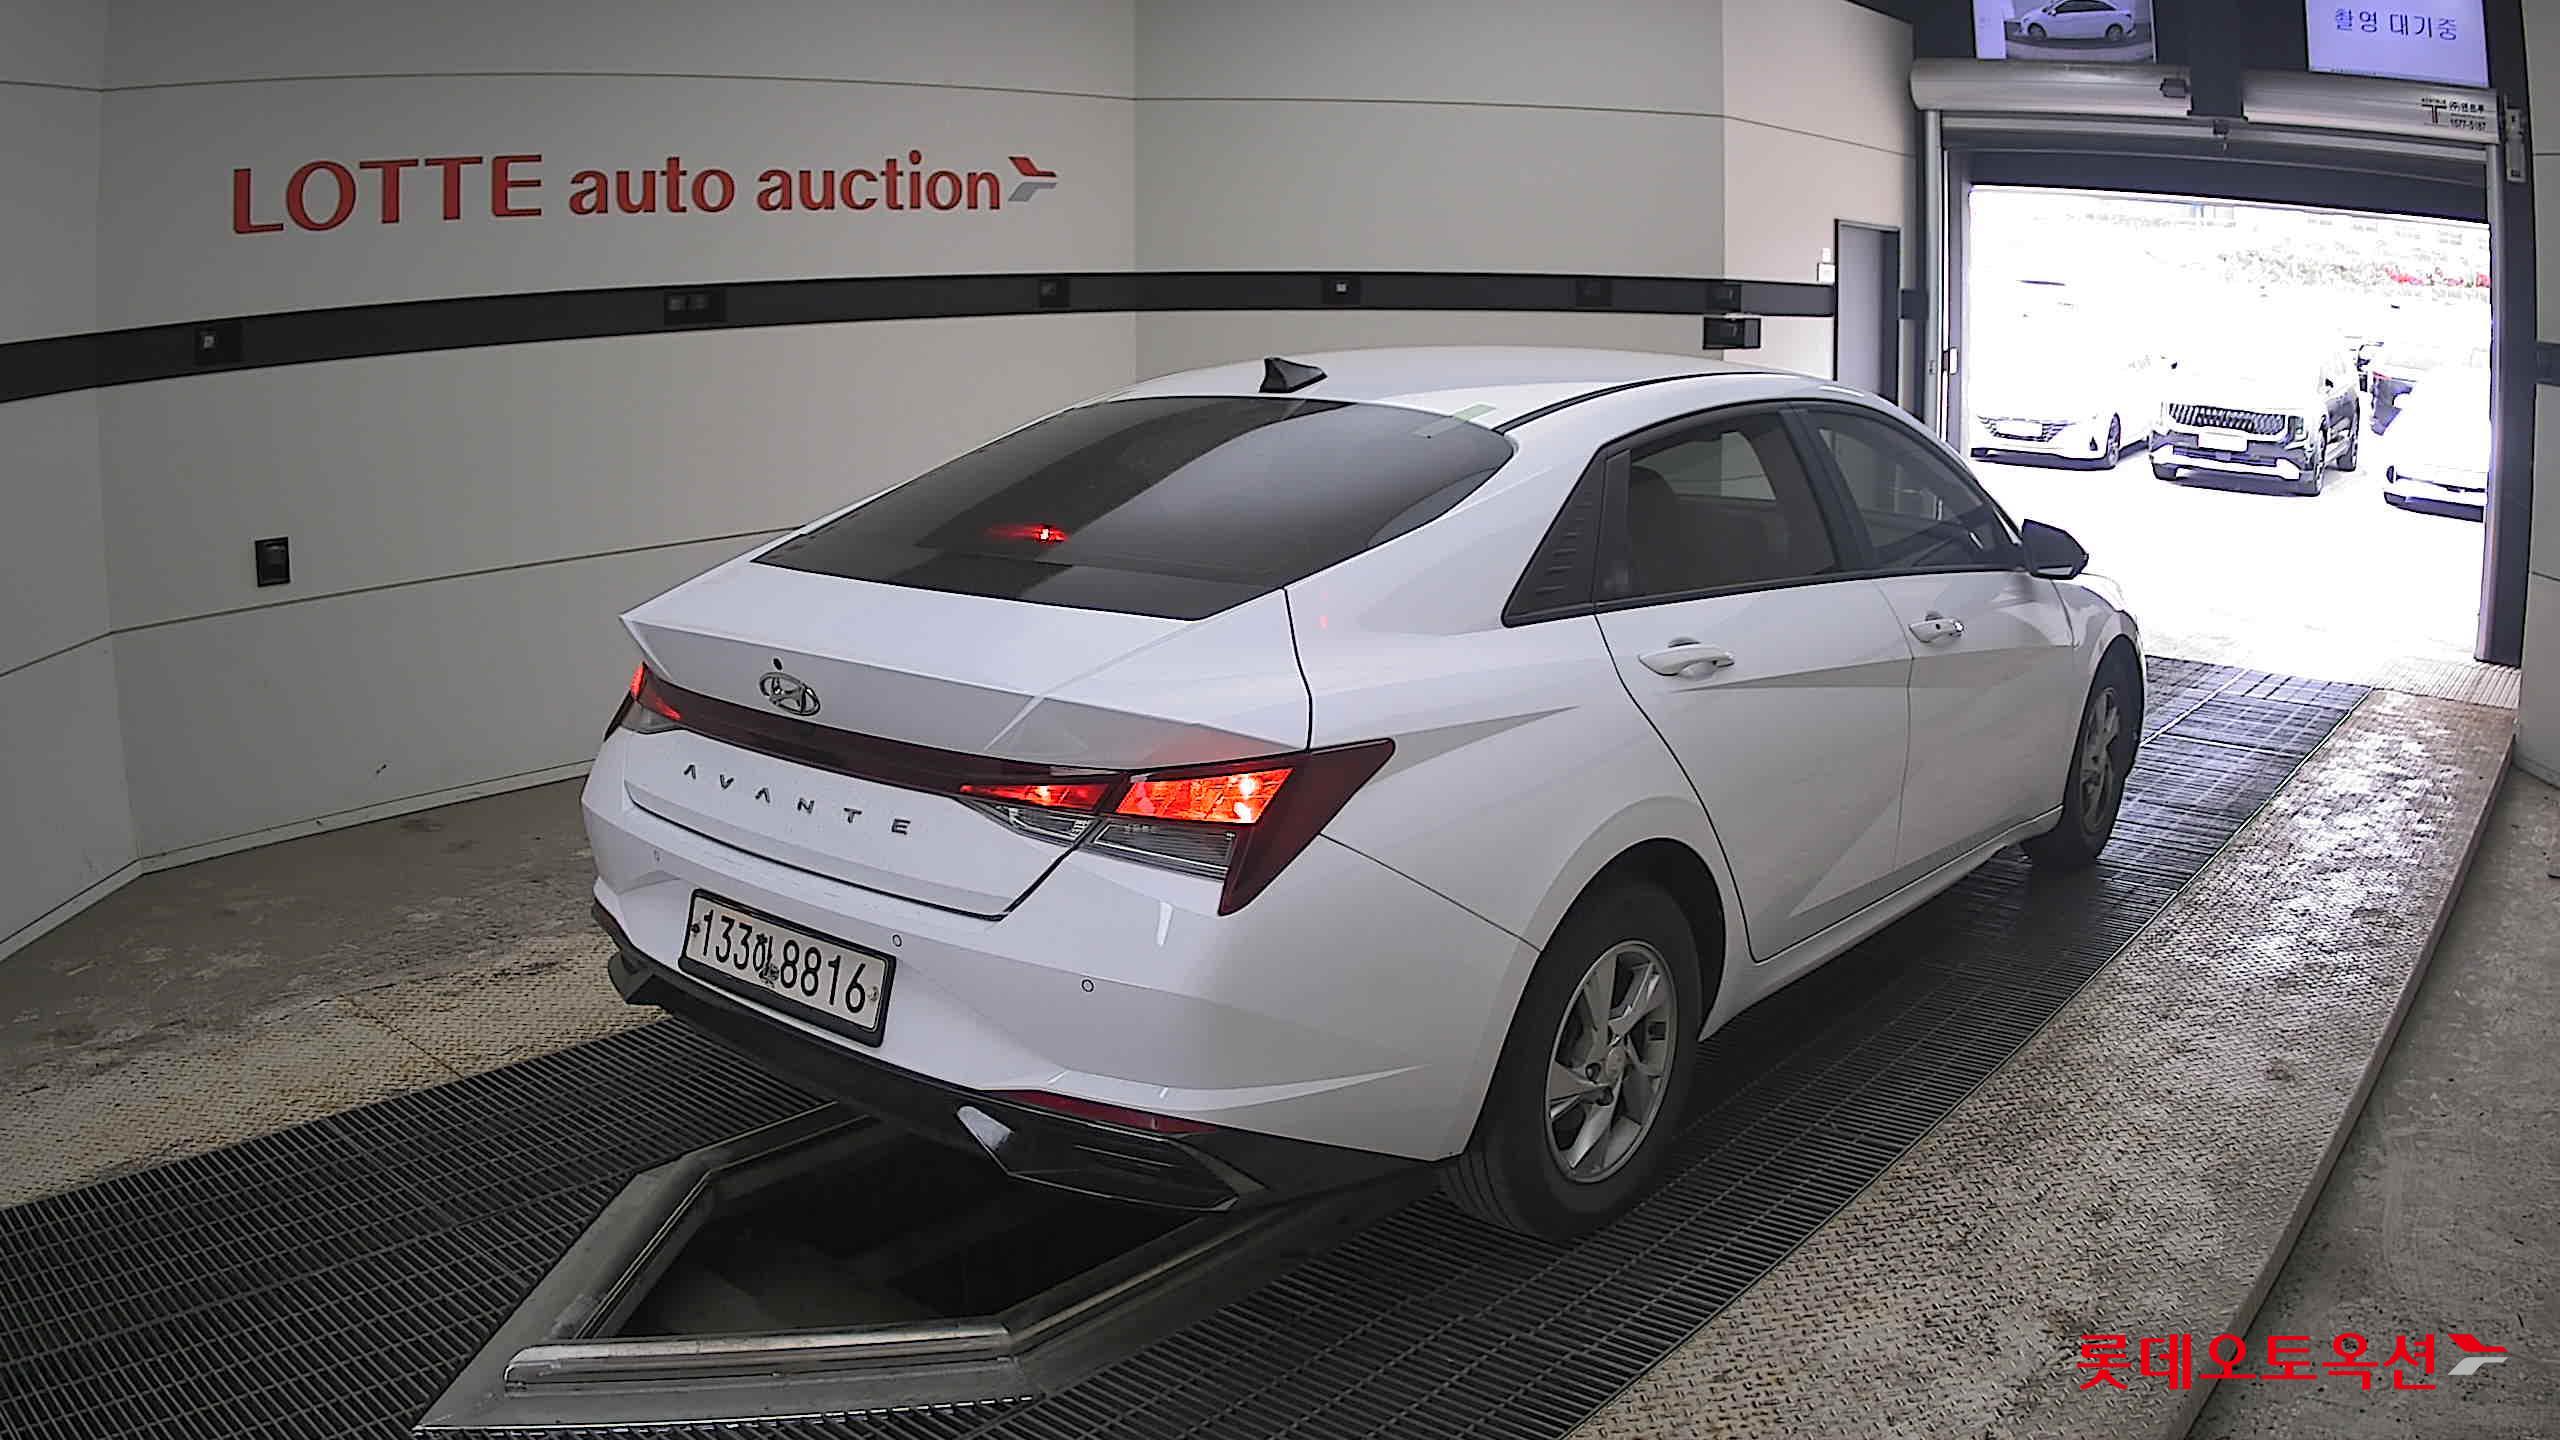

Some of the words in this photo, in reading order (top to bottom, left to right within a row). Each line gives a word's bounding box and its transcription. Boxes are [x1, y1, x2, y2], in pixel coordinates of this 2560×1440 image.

[2390, 13, 2457, 41] 대기중
[233, 153, 543, 235] LOTTE
[568, 156, 736, 215] auto
[756, 150, 1002, 213] auction
[683, 763, 912, 836] AVANTE
